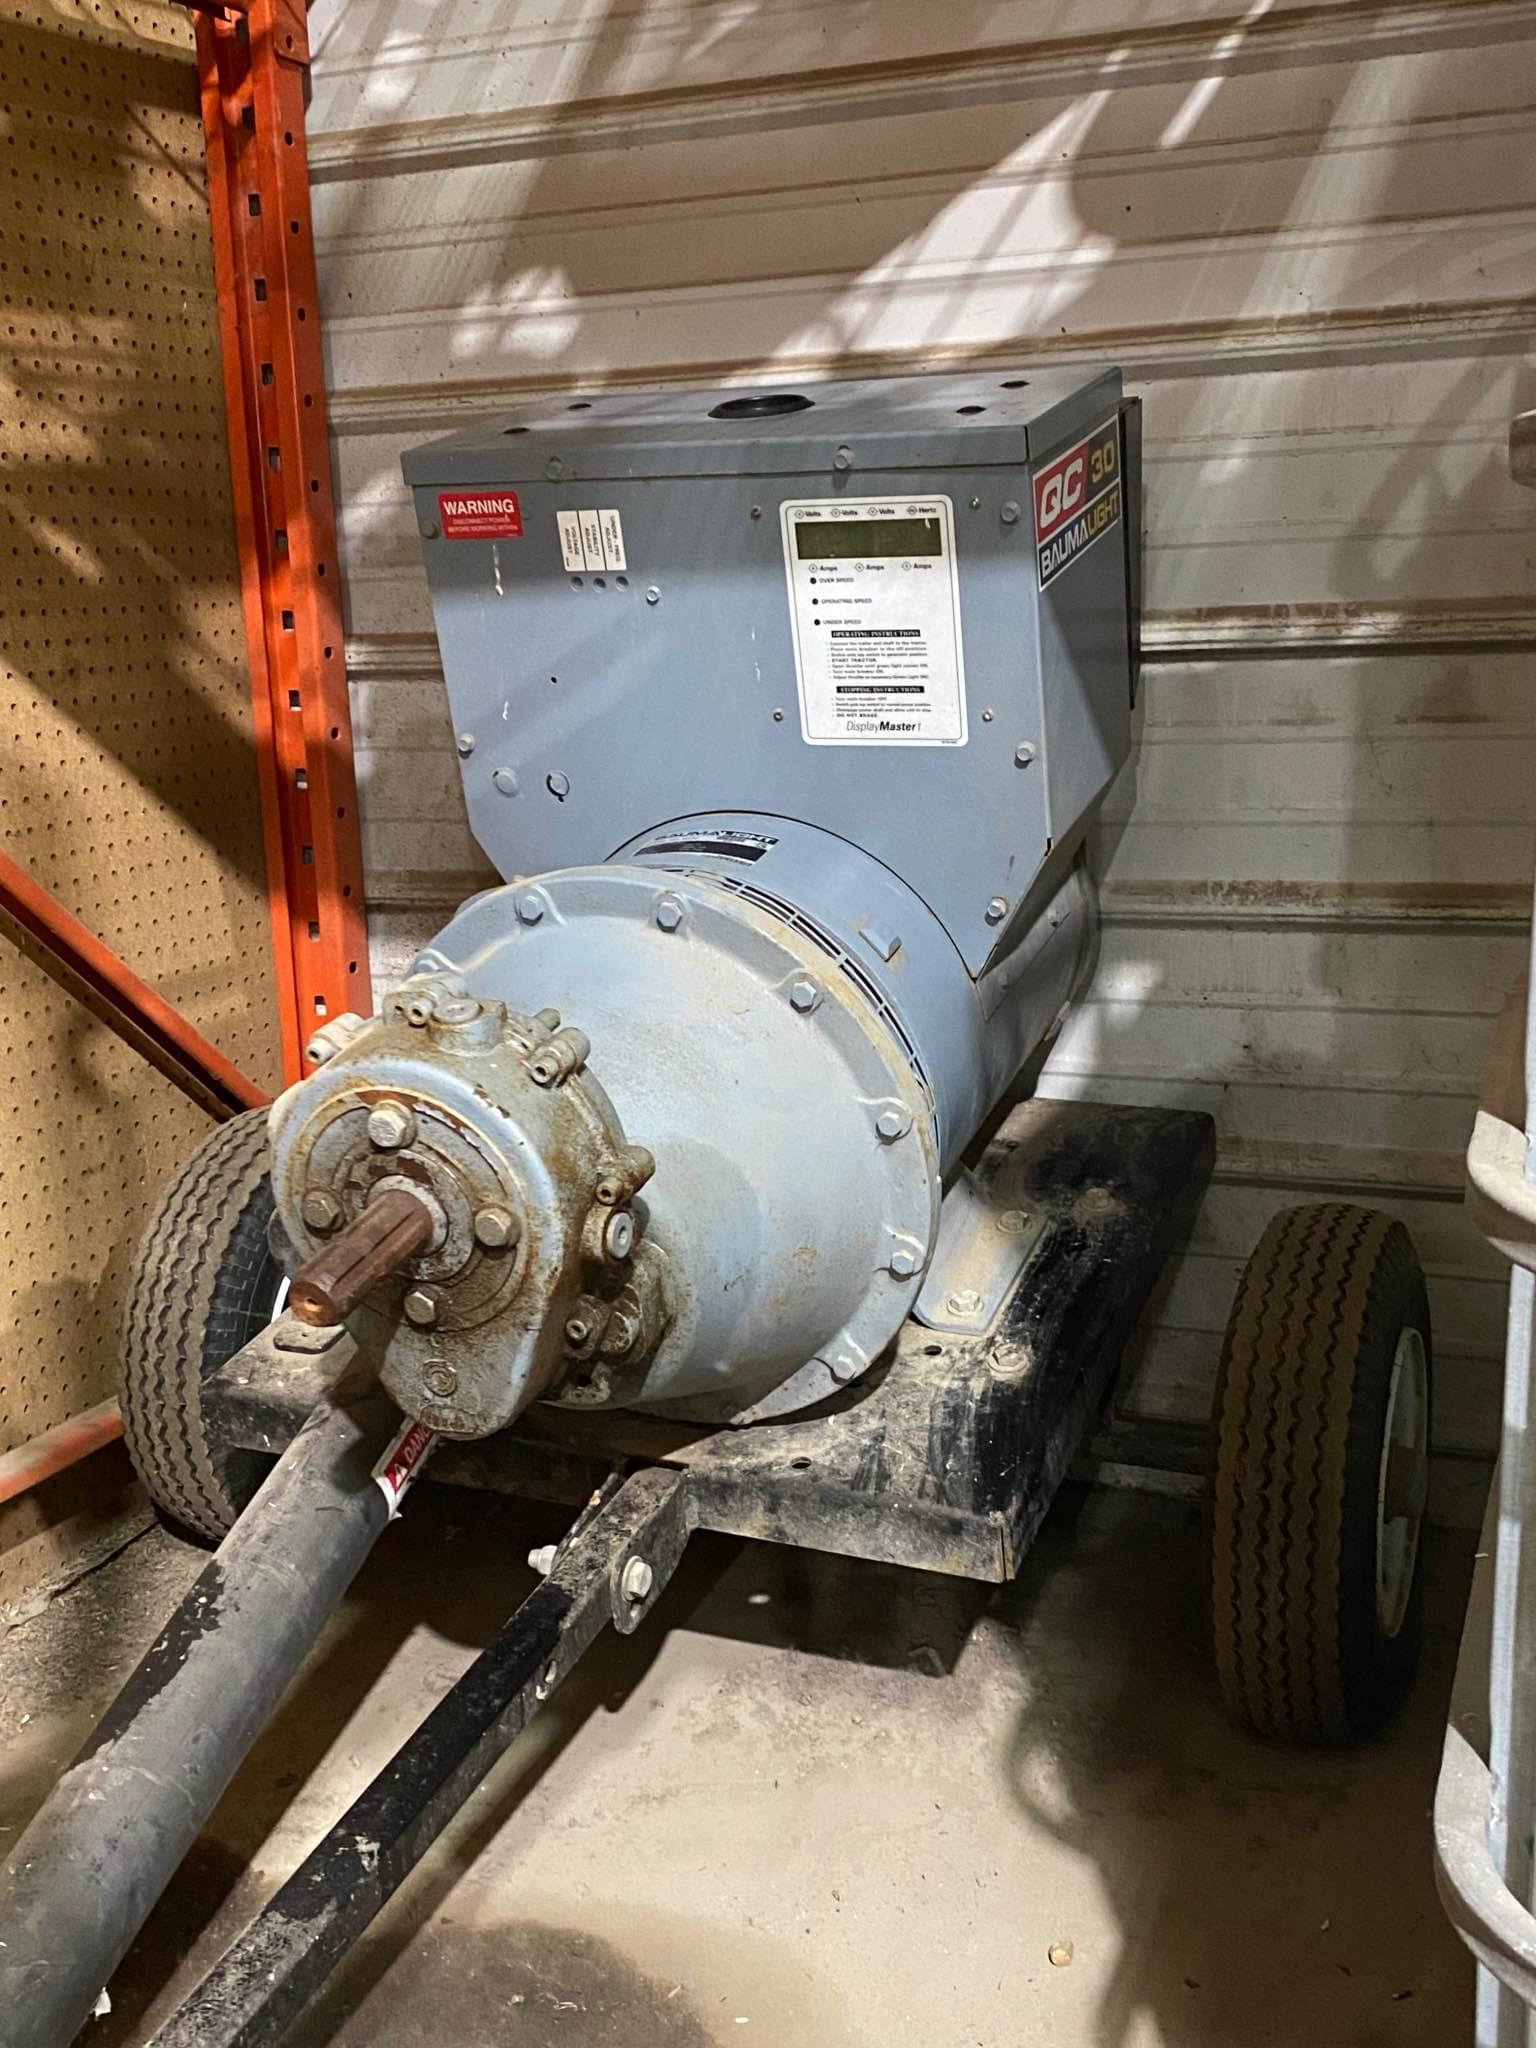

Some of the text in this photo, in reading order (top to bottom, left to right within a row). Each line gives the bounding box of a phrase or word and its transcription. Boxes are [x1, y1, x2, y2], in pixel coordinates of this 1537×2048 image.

[443, 498, 515, 516] WARNING
[1040, 439, 1115, 529] QC 30
[1041, 489, 1120, 579] BAUMALIGHT
